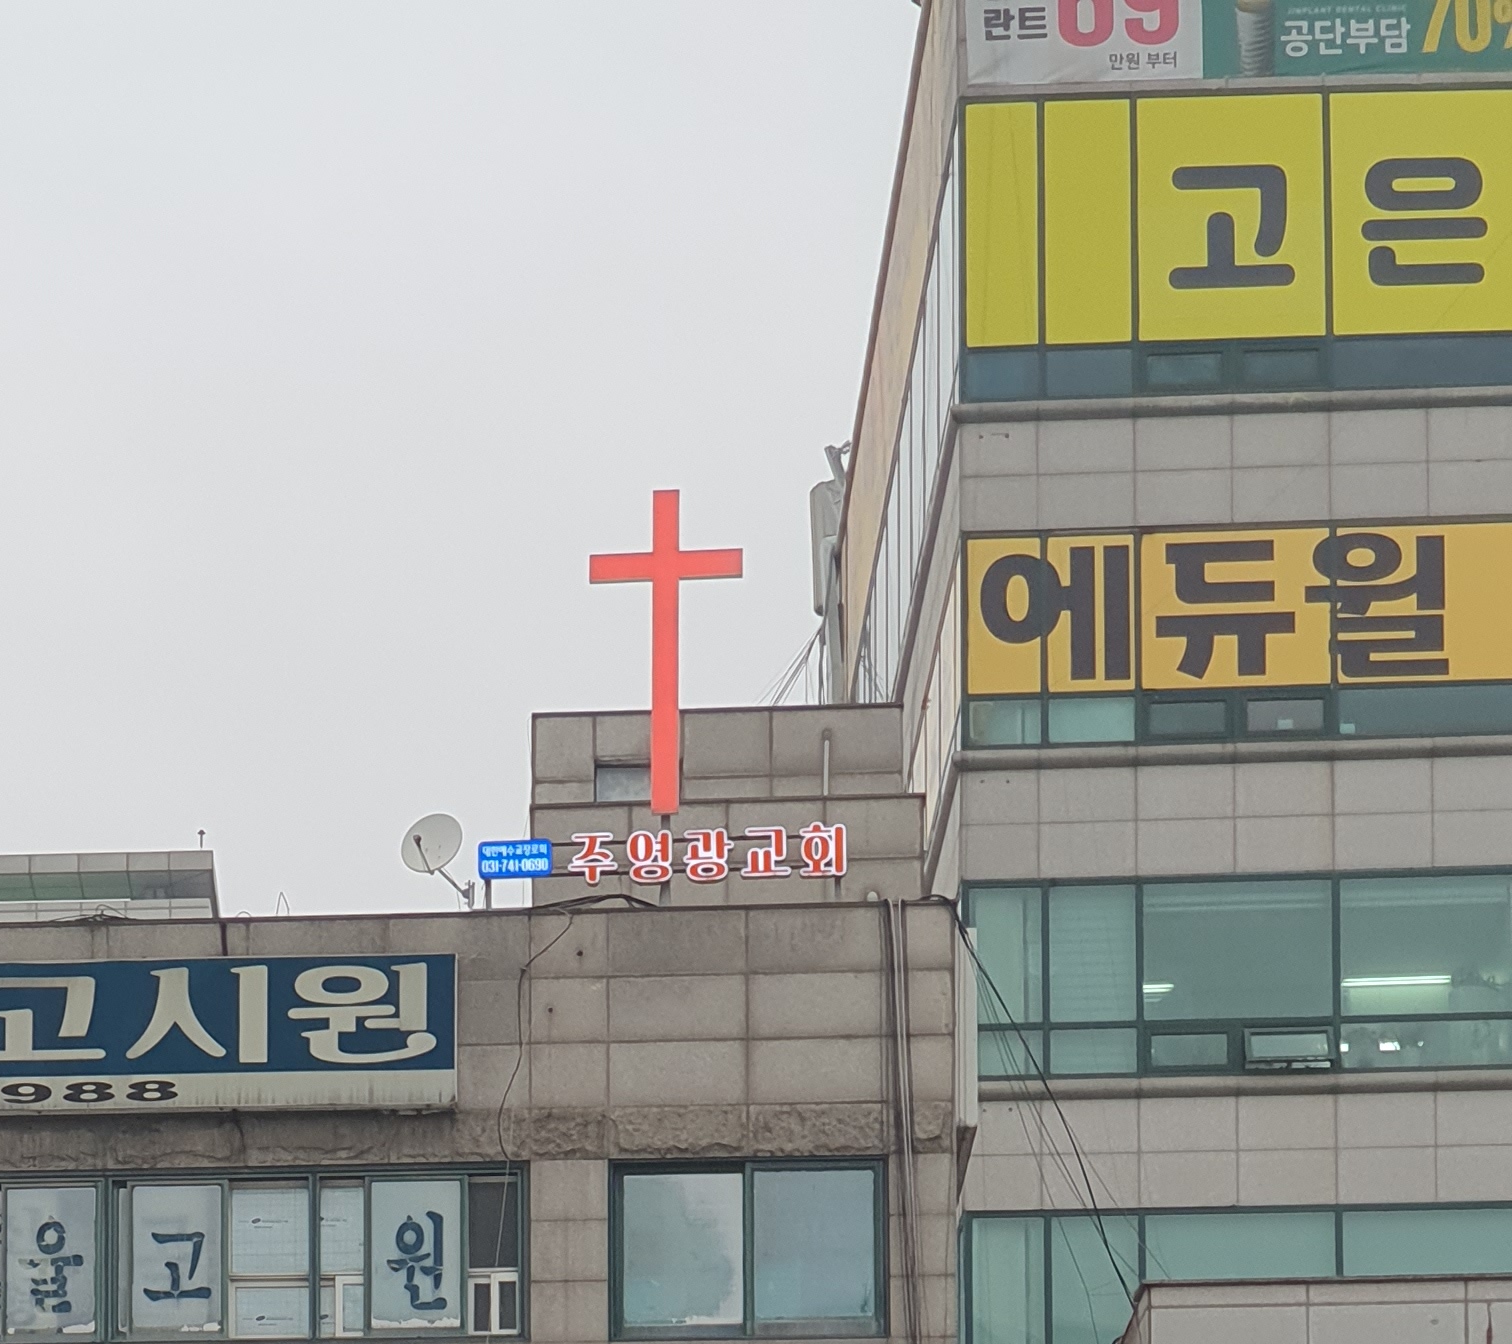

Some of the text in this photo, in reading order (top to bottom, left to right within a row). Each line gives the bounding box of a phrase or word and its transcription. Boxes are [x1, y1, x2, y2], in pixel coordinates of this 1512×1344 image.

[983, 7, 1048, 41] 란트
[1280, 17, 1411, 57] 공단부담
[1109, 51, 1178, 70] 만원 부터
[1168, 157, 1488, 290] 고은
[979, 532, 1450, 681] 에듀윌
[481, 858, 550, 873] 031-741-0690
[568, 821, 848, 885] 주영광교회
